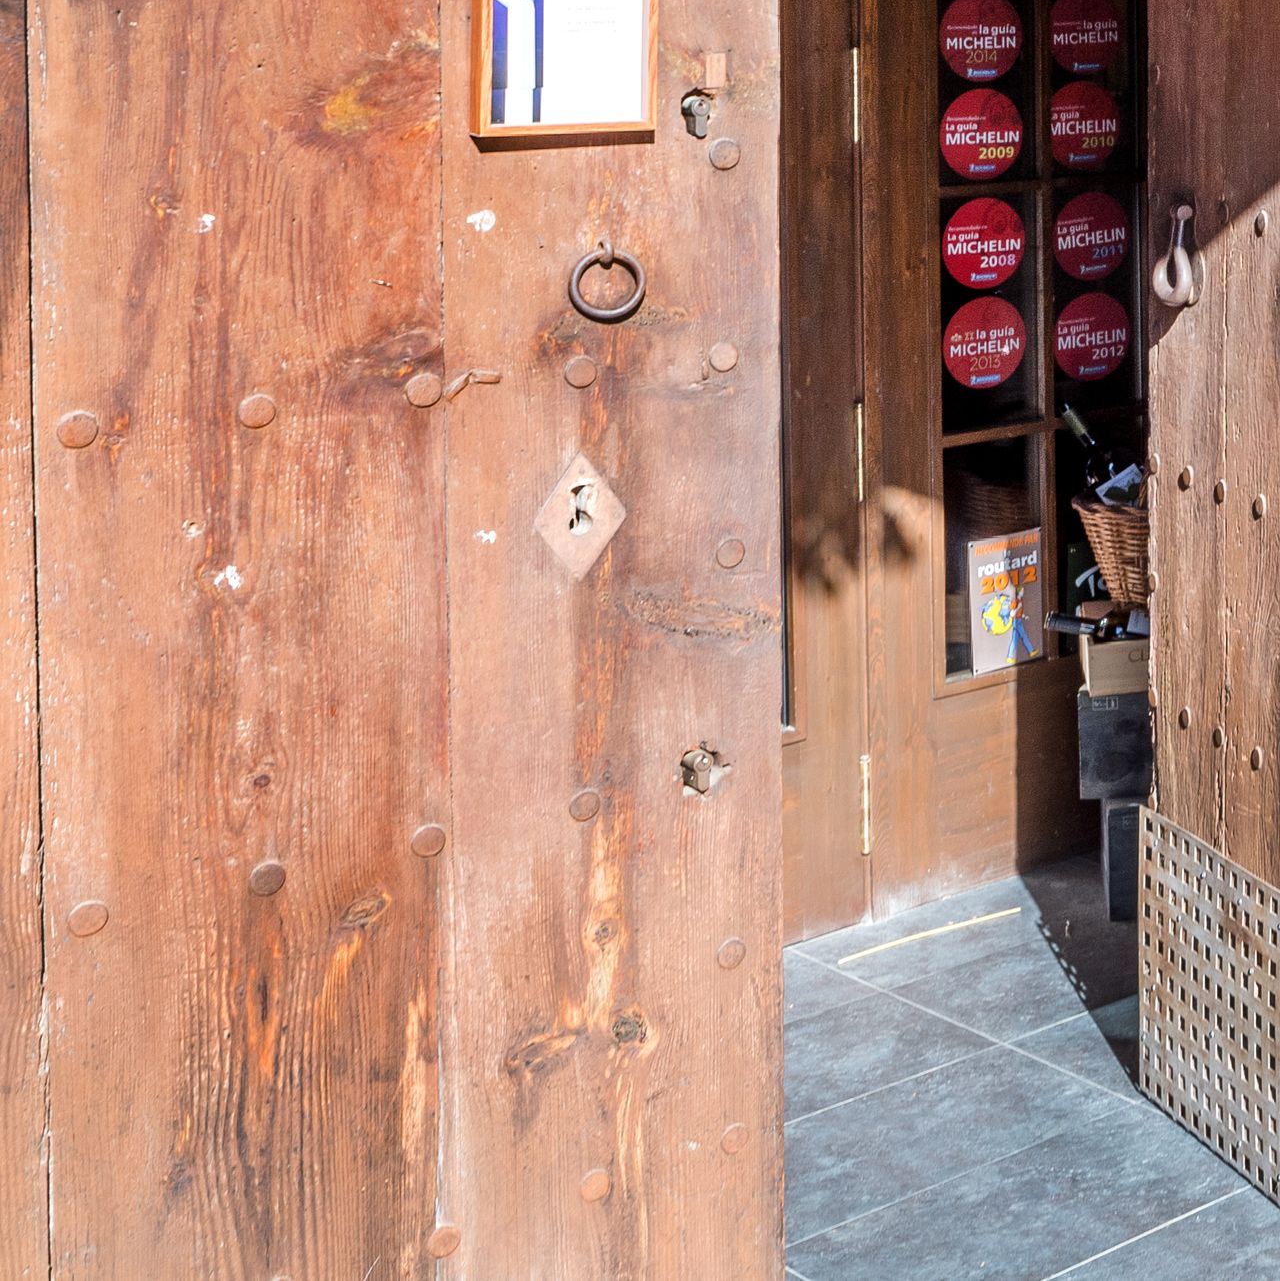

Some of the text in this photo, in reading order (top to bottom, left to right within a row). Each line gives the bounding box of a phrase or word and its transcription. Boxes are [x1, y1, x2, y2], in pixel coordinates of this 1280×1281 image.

[979, 24, 989, 35] la
[991, 23, 1016, 36] guía
[1083, 20, 1093, 29] la
[946, 36, 1016, 50] MICHELIN
[1053, 30, 1118, 45] MICHELIN
[965, 50, 997, 63] 2014
[945, 122, 956, 131] La
[1051, 119, 1116, 136] MICHELIN
[945, 131, 1019, 145] MICHELIN
[1081, 136, 1115, 149] 2010
[978, 146, 1014, 160] 2009
[947, 233, 957, 242] La
[1057, 225, 1067, 235] La
[947, 237, 1021, 255] MICHELIN
[1058, 226, 1125, 251] MICHELIN
[1092, 243, 1124, 259] 2011
[980, 253, 1016, 269] 2008
[976, 325, 1015, 340] la guía
[1058, 325, 1068, 335] La
[1058, 328, 1126, 351] MICHELIN
[950, 337, 1020, 358] MICHELIN
[1092, 345, 1125, 360] 2012
[969, 356, 1001, 371] 2013
[977, 550, 1038, 578] routard
[980, 566, 1038, 595] 2012
